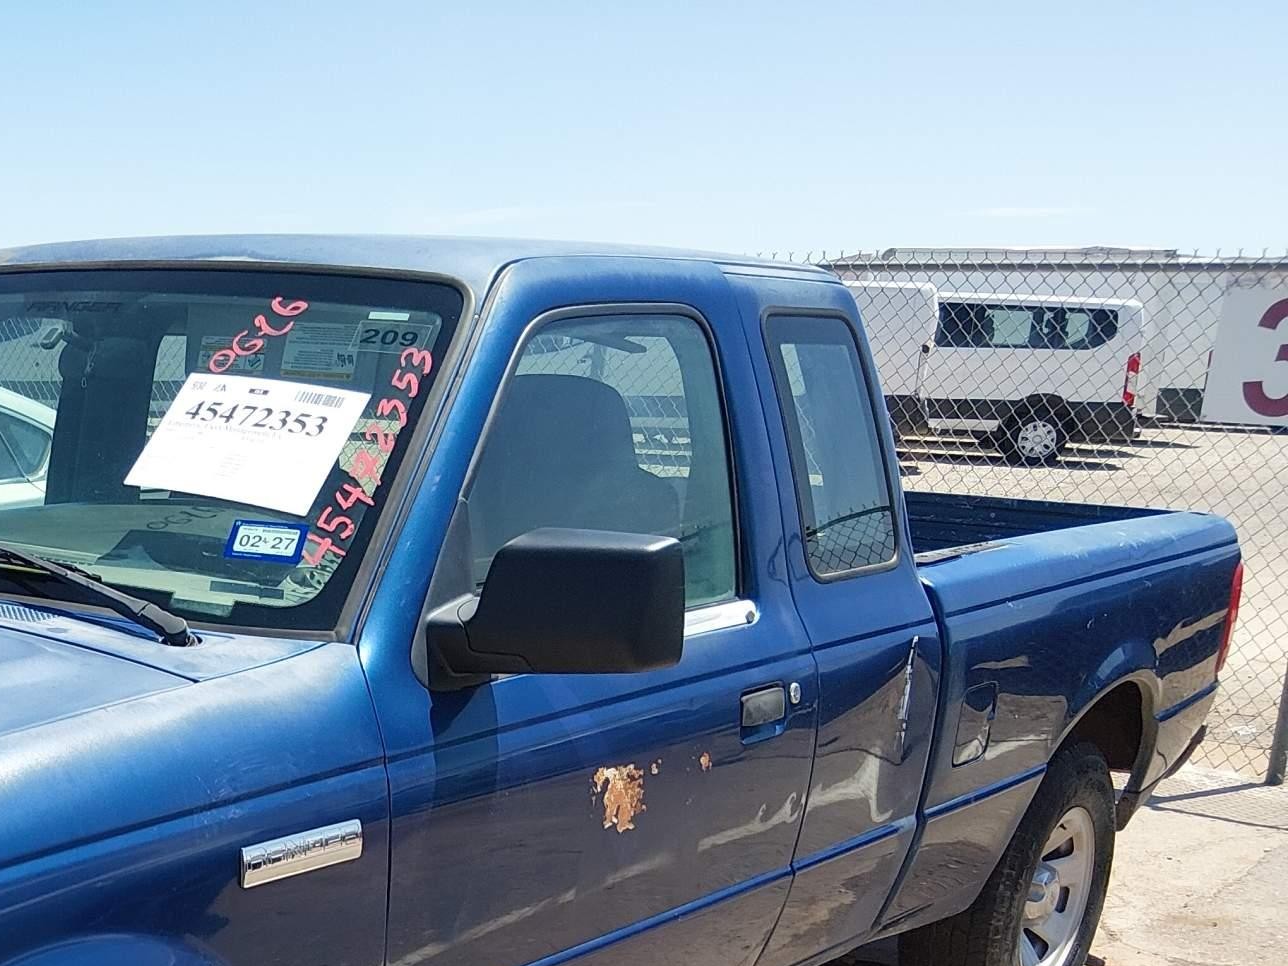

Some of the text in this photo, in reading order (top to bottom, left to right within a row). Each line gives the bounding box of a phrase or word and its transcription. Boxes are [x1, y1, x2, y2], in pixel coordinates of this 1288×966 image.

[359, 328, 419, 347] 209
[1242, 297, 1288, 418] 3
[185, 399, 329, 437] 45472353
[238, 534, 296, 551] 02 27
